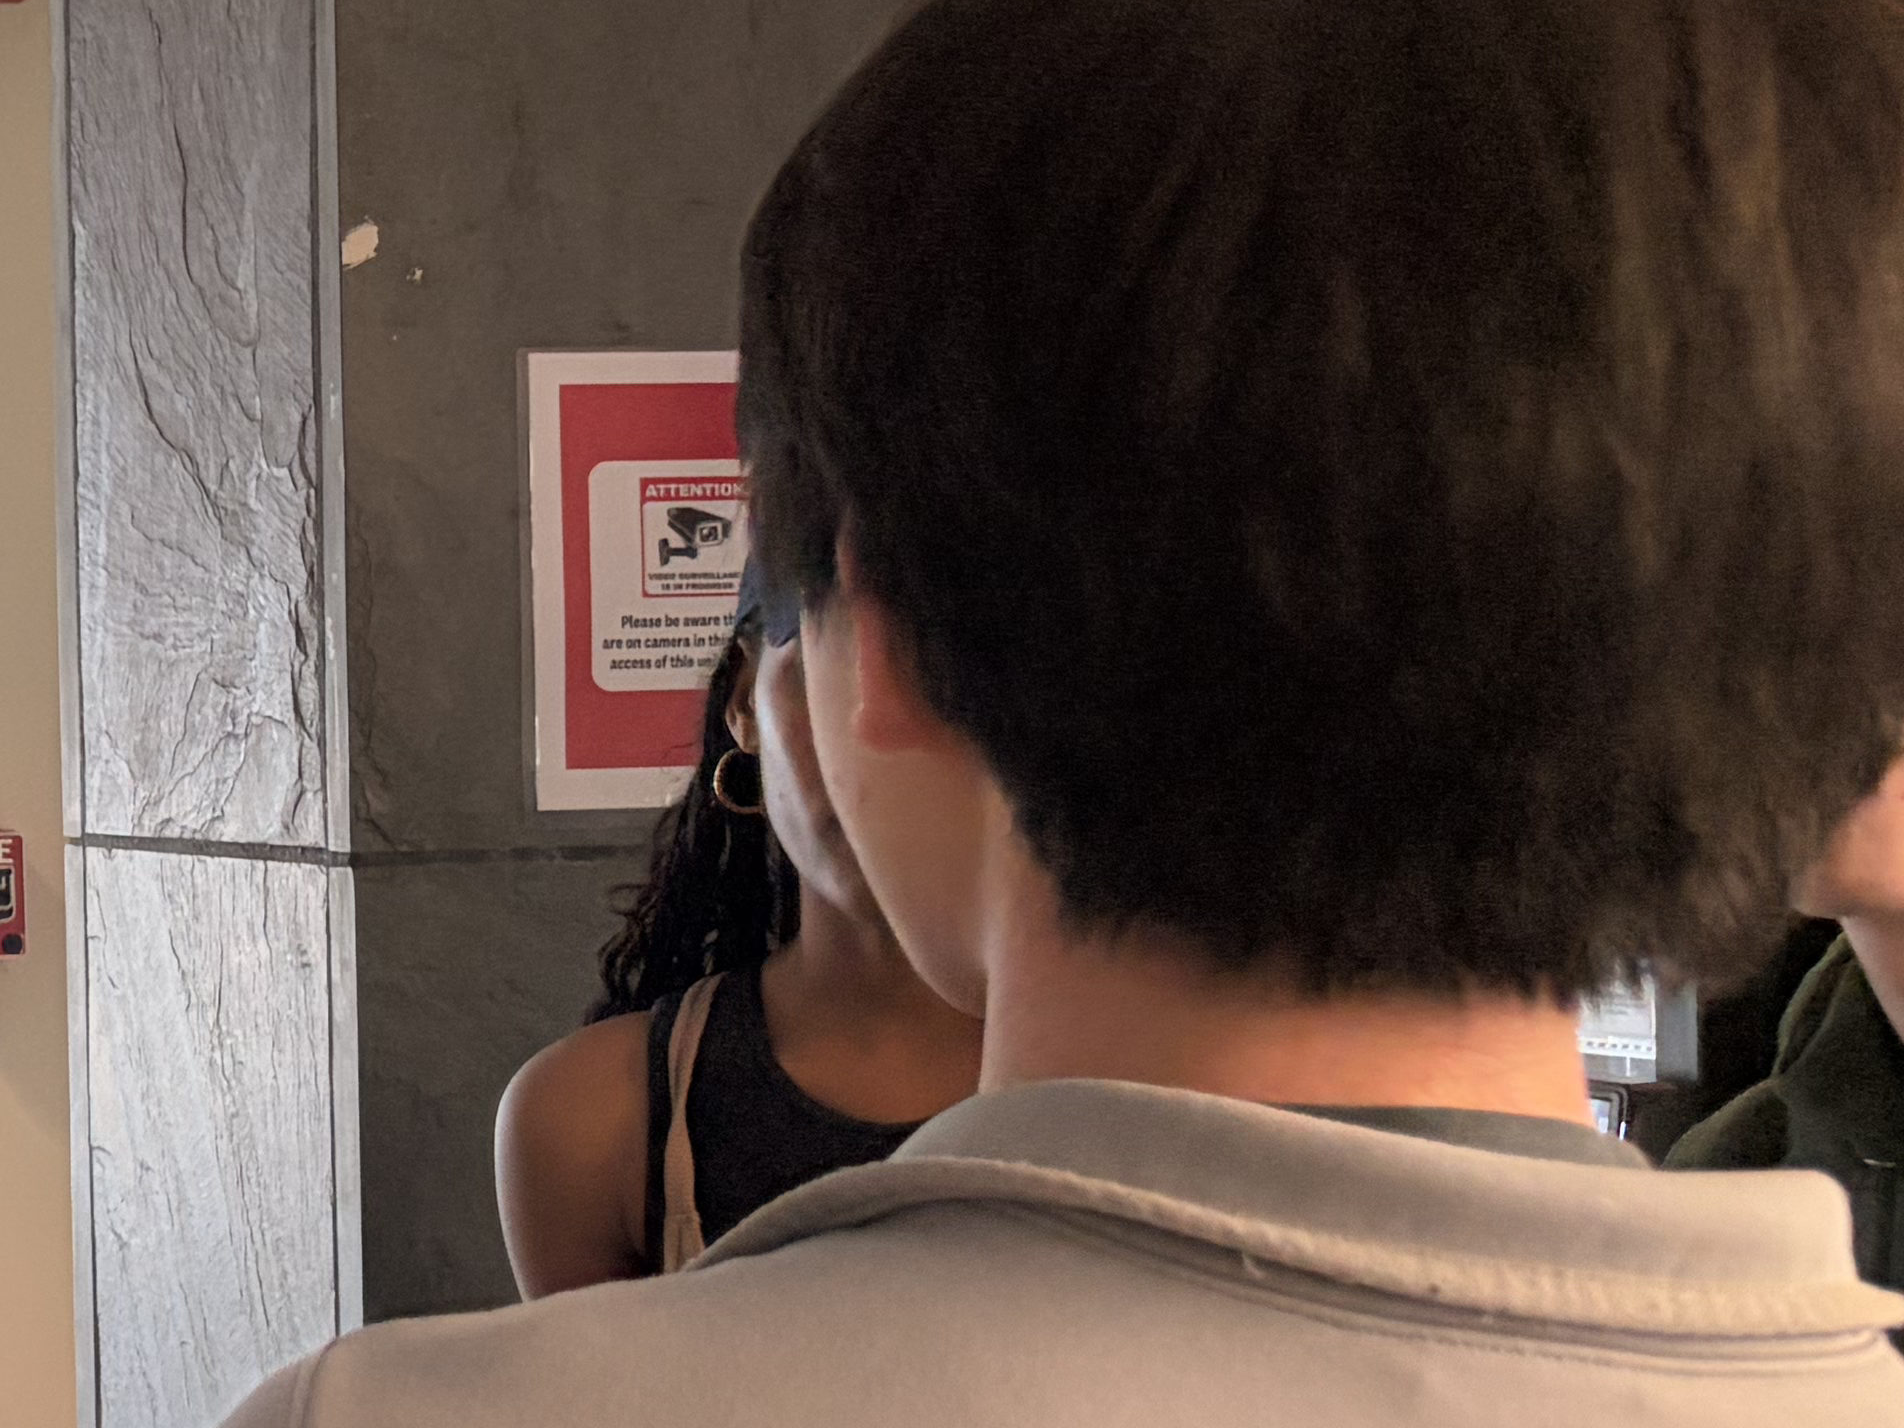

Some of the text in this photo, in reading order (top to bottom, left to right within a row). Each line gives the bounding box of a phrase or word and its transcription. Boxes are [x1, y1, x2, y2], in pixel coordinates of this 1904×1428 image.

[621, 615, 662, 629] Please
[665, 614, 679, 627] be
[683, 616, 720, 627] aware
[602, 638, 623, 650] are
[626, 638, 641, 649] on
[644, 636, 690, 649] camera
[693, 633, 705, 647] in
[610, 658, 652, 670] access
[655, 655, 669, 669] of
[671, 654, 694, 669] this
